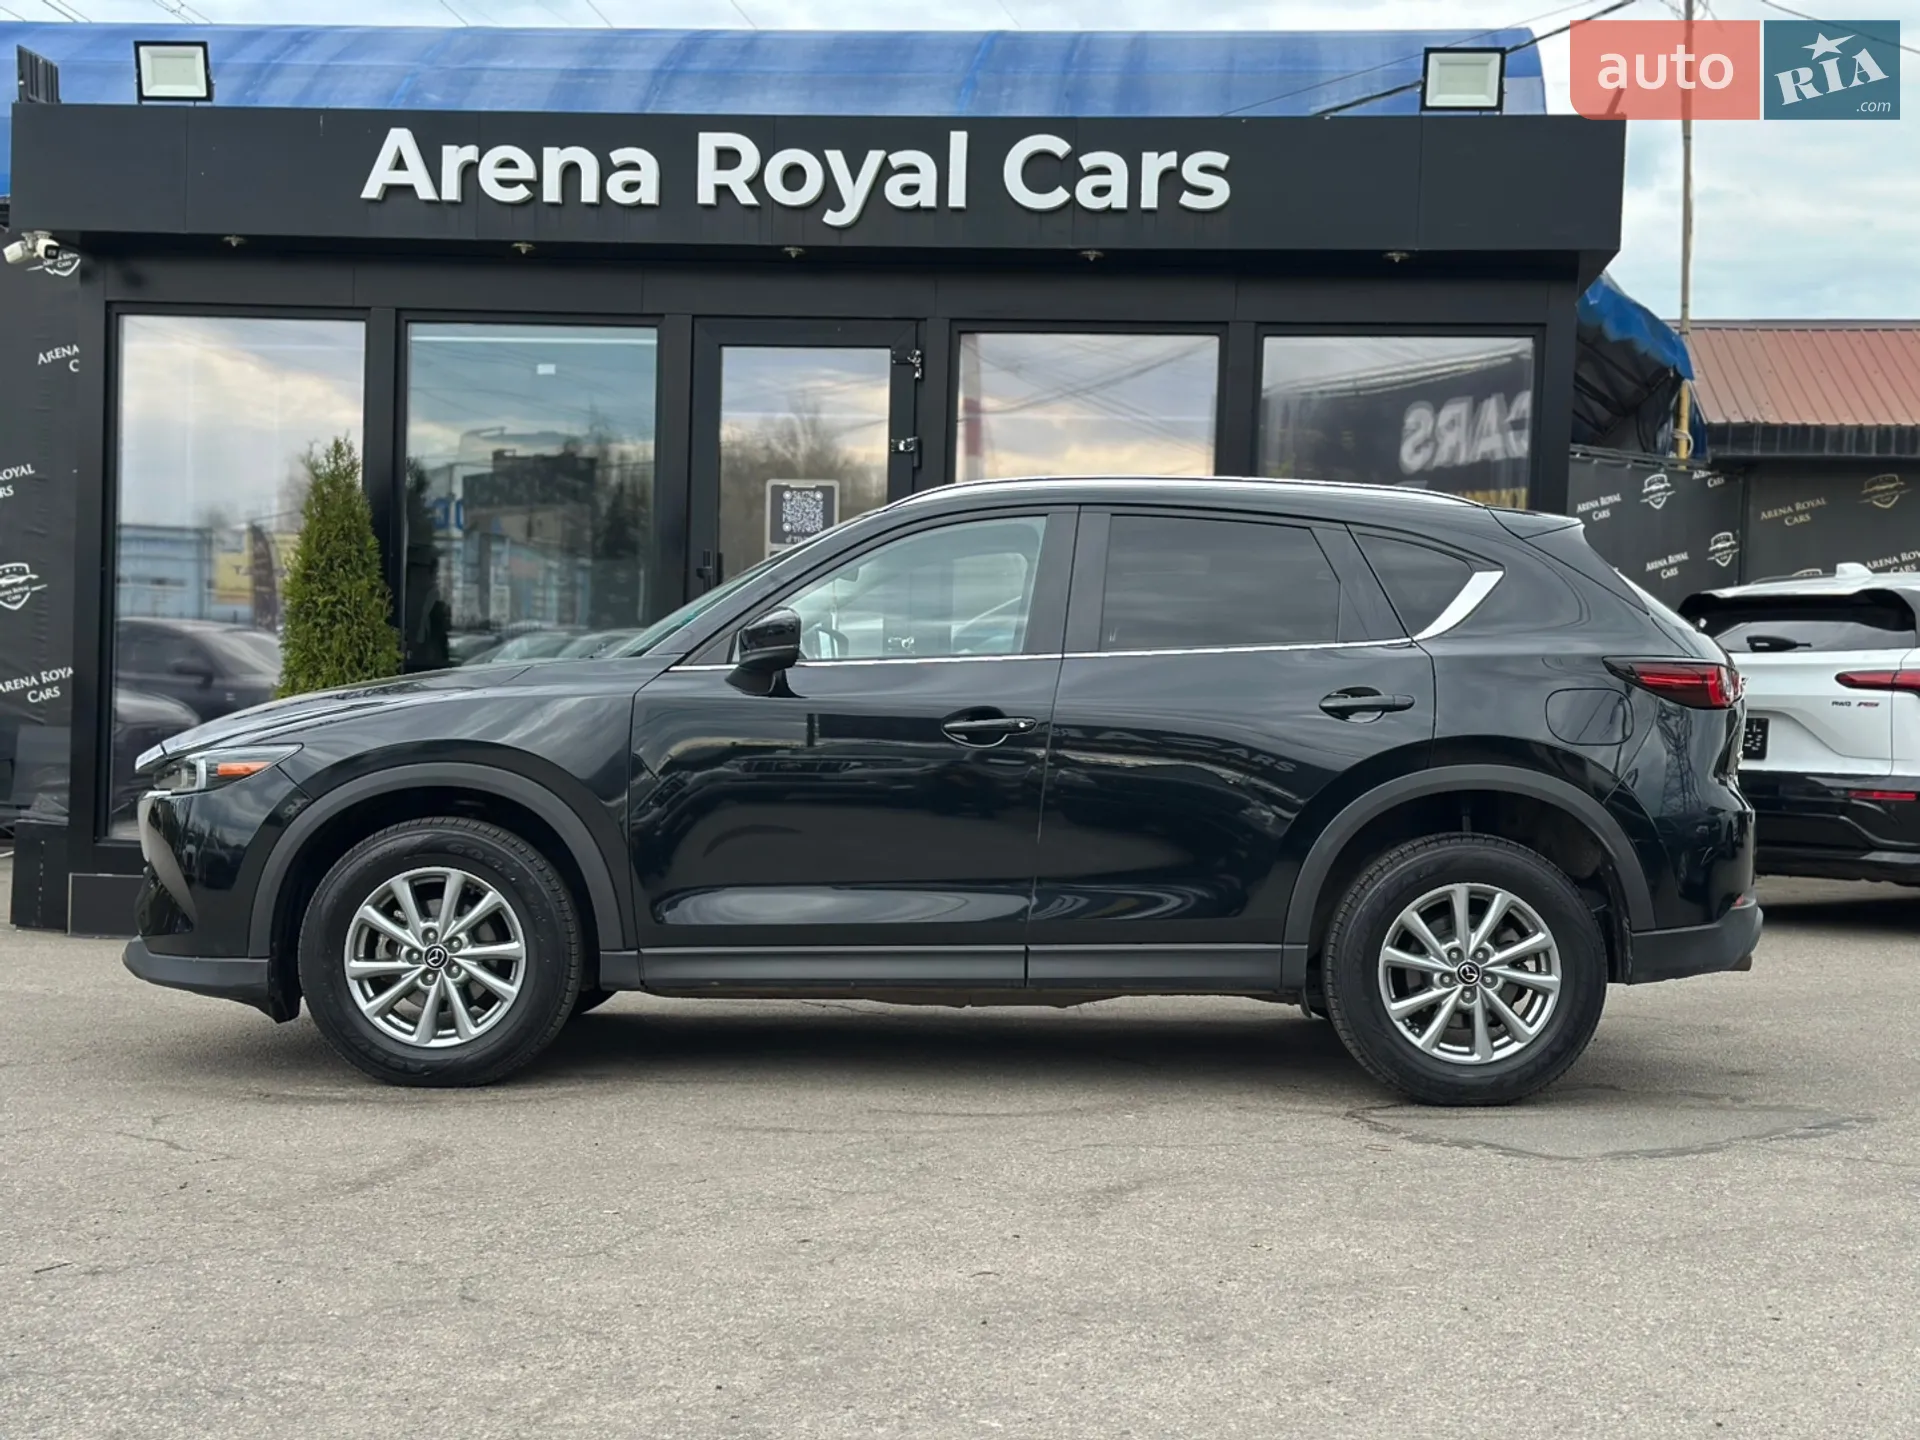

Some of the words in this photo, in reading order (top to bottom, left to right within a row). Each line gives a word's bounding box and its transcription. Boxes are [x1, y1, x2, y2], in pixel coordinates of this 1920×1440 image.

[360, 128, 660, 206] Arena
[697, 131, 968, 228] Royal
[1003, 134, 1231, 212] Cars
[37, 344, 79, 365] ARENA
[1576, 499, 1600, 514] ARENA
[1600, 493, 1622, 505] ROYAL
[1760, 506, 1793, 520] ARENA
[1795, 497, 1828, 512] ROYAL
[1592, 508, 1611, 521] CARS
[1784, 513, 1812, 526] CARS
[1645, 558, 1668, 572] ARENA
[1667, 551, 1689, 564] ROYAL
[1866, 556, 1900, 569] ARENA
[1660, 566, 1679, 579] CARS
[27, 686, 61, 703] CARS
